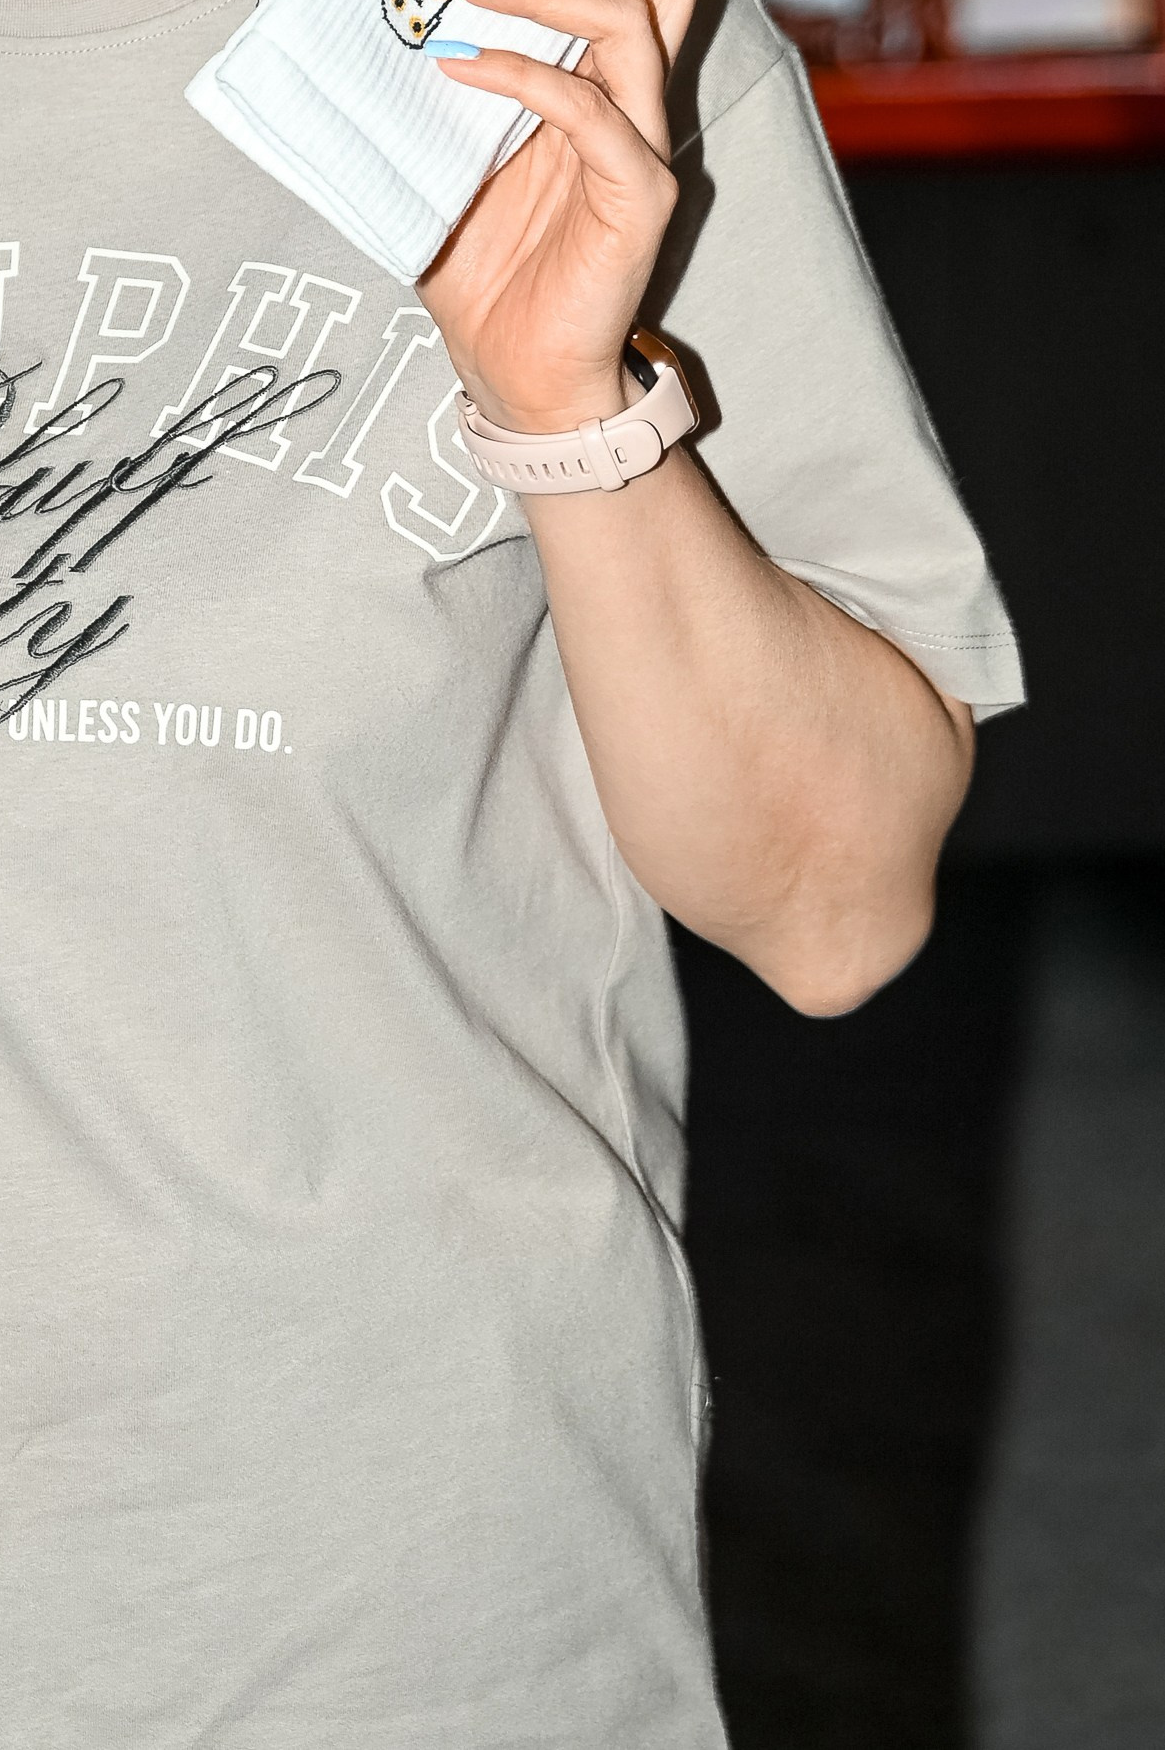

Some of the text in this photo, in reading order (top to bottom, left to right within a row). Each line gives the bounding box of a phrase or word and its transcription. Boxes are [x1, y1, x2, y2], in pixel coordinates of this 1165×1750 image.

[7, 697, 142, 746] UNLESS
[153, 702, 224, 749] YOU
[234, 707, 293, 756] DO.
